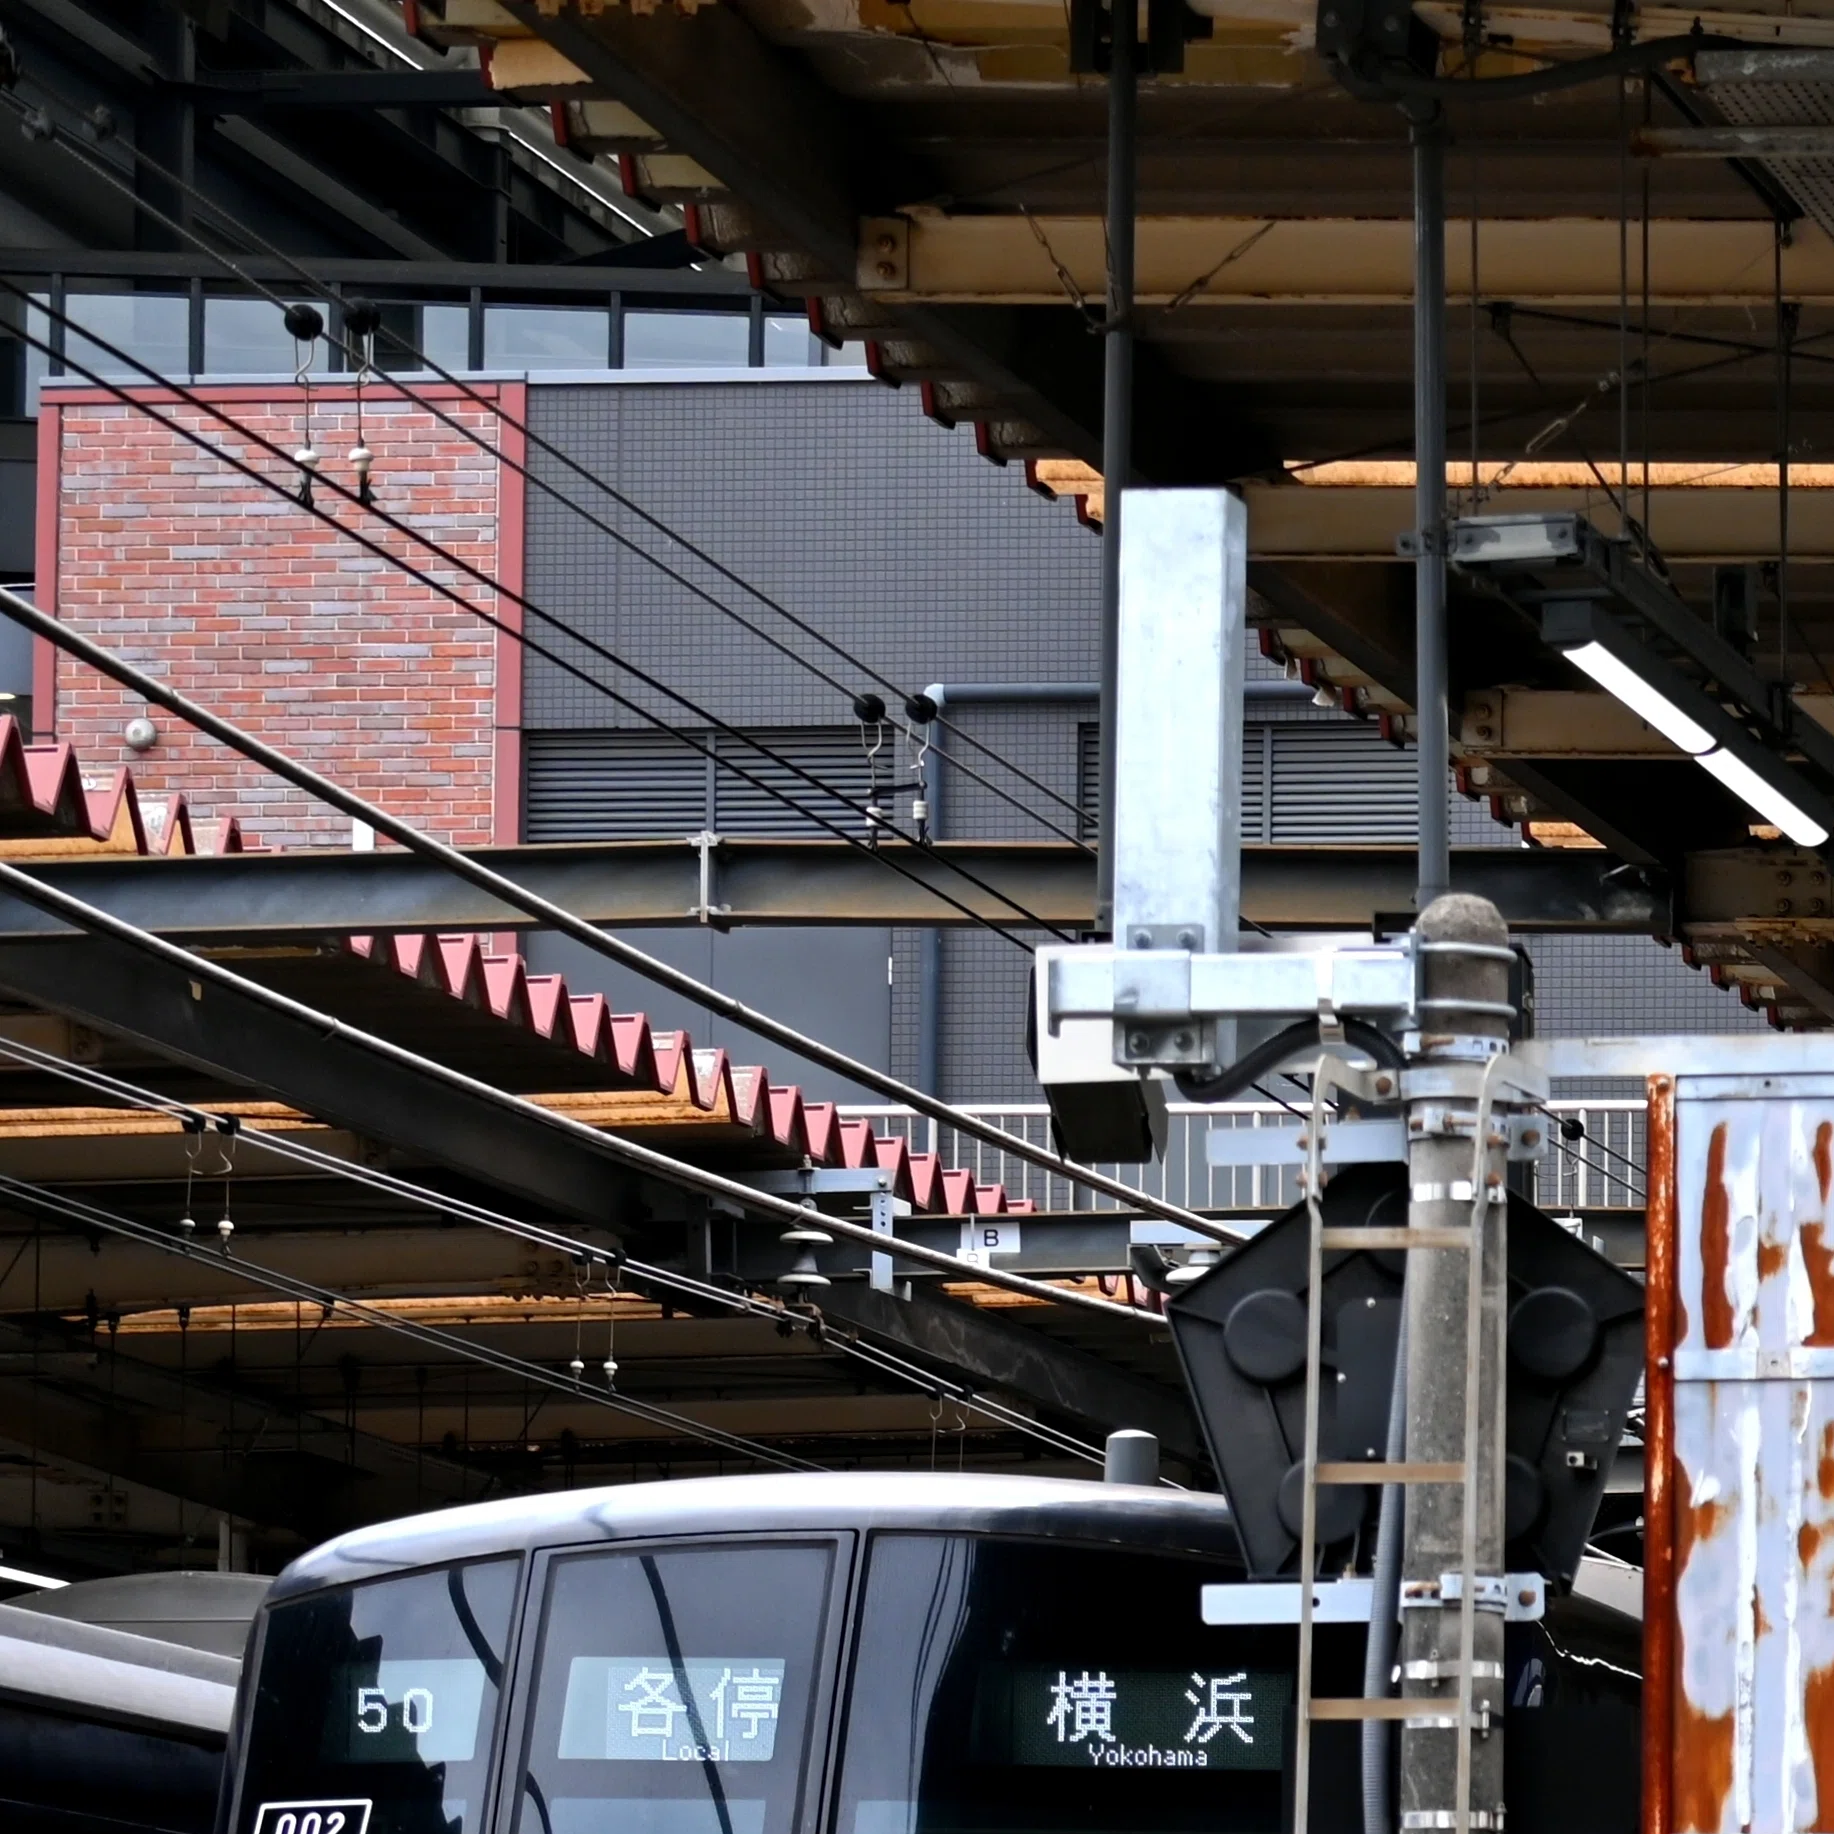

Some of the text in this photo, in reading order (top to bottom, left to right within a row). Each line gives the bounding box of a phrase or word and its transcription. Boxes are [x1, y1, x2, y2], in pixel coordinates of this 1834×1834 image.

[984, 1228, 999, 1247] B
[357, 1687, 434, 1734] 50
[618, 1666, 780, 1739] 各停
[1047, 1670, 1254, 1743] 横浜
[661, 1739, 730, 1762] Local
[1089, 1743, 1208, 1766] Yokohama
